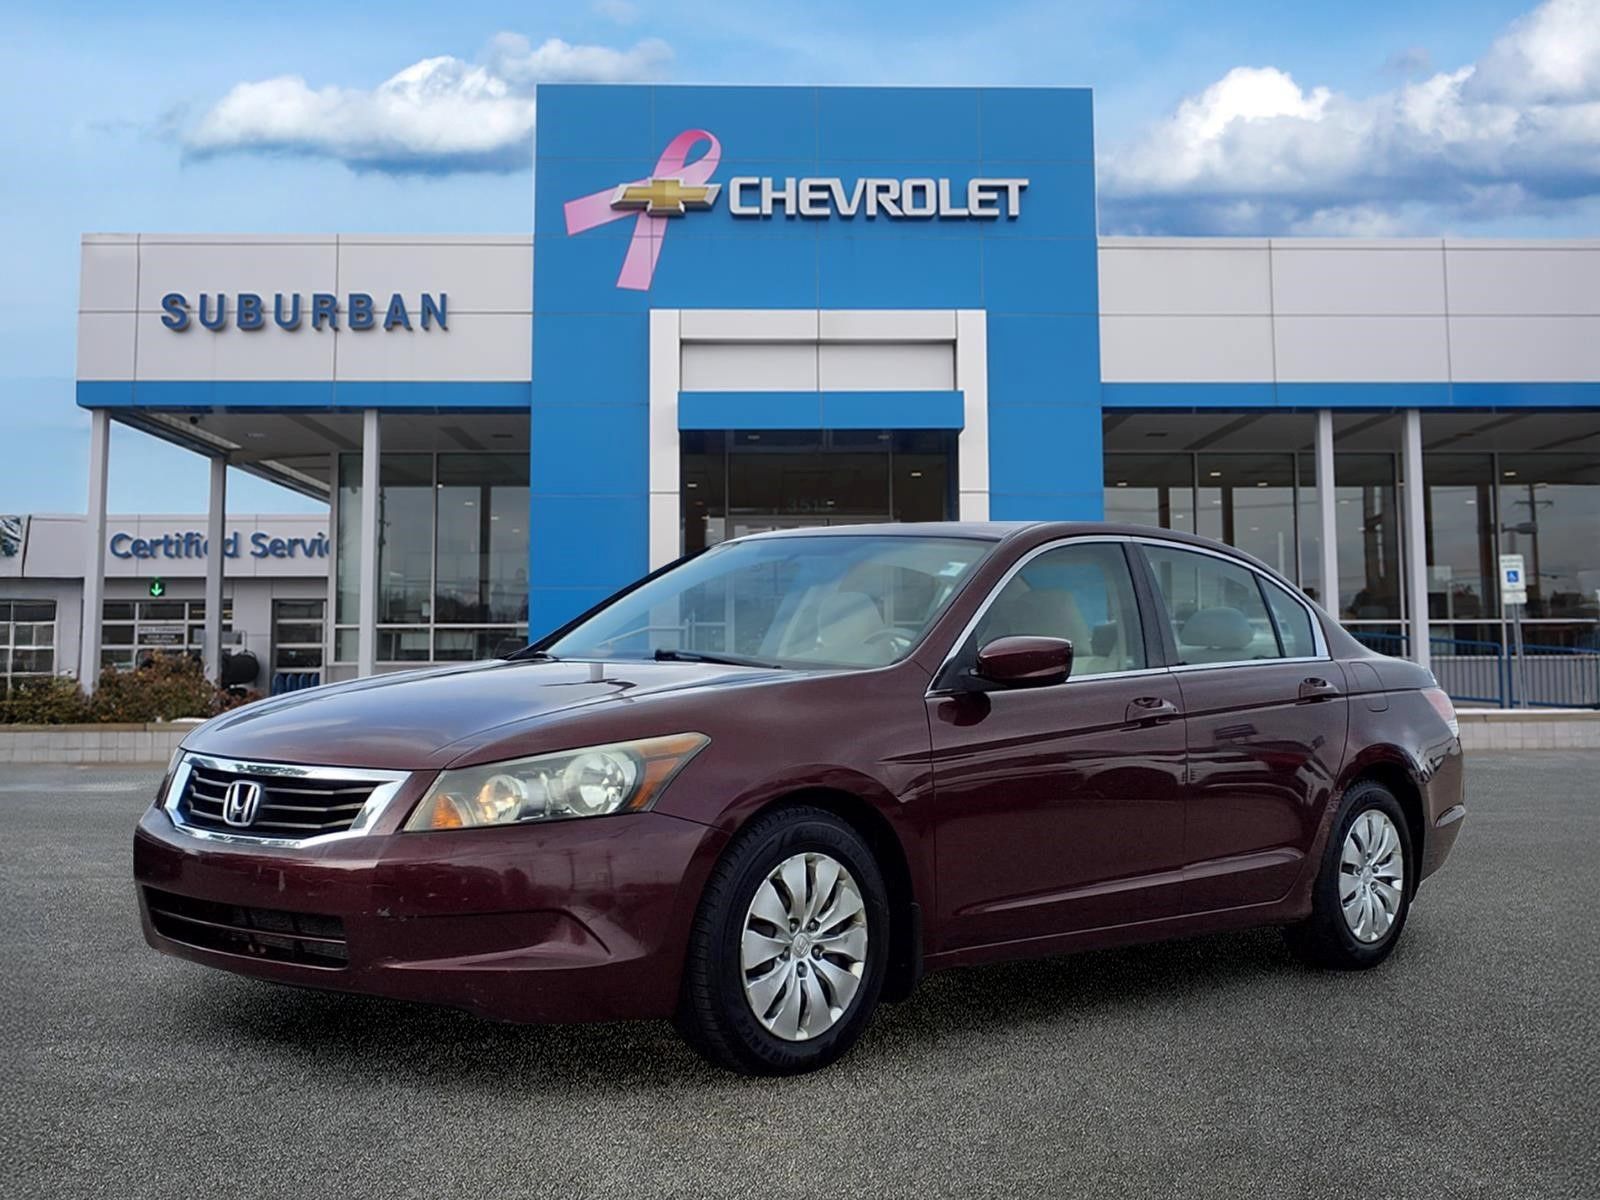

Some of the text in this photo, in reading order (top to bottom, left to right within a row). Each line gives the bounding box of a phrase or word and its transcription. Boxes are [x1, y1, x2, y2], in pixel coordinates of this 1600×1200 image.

[729, 176, 1029, 217] CHEVROLET
[160, 292, 449, 332] SUBURBAN
[110, 531, 240, 560] Certifid
